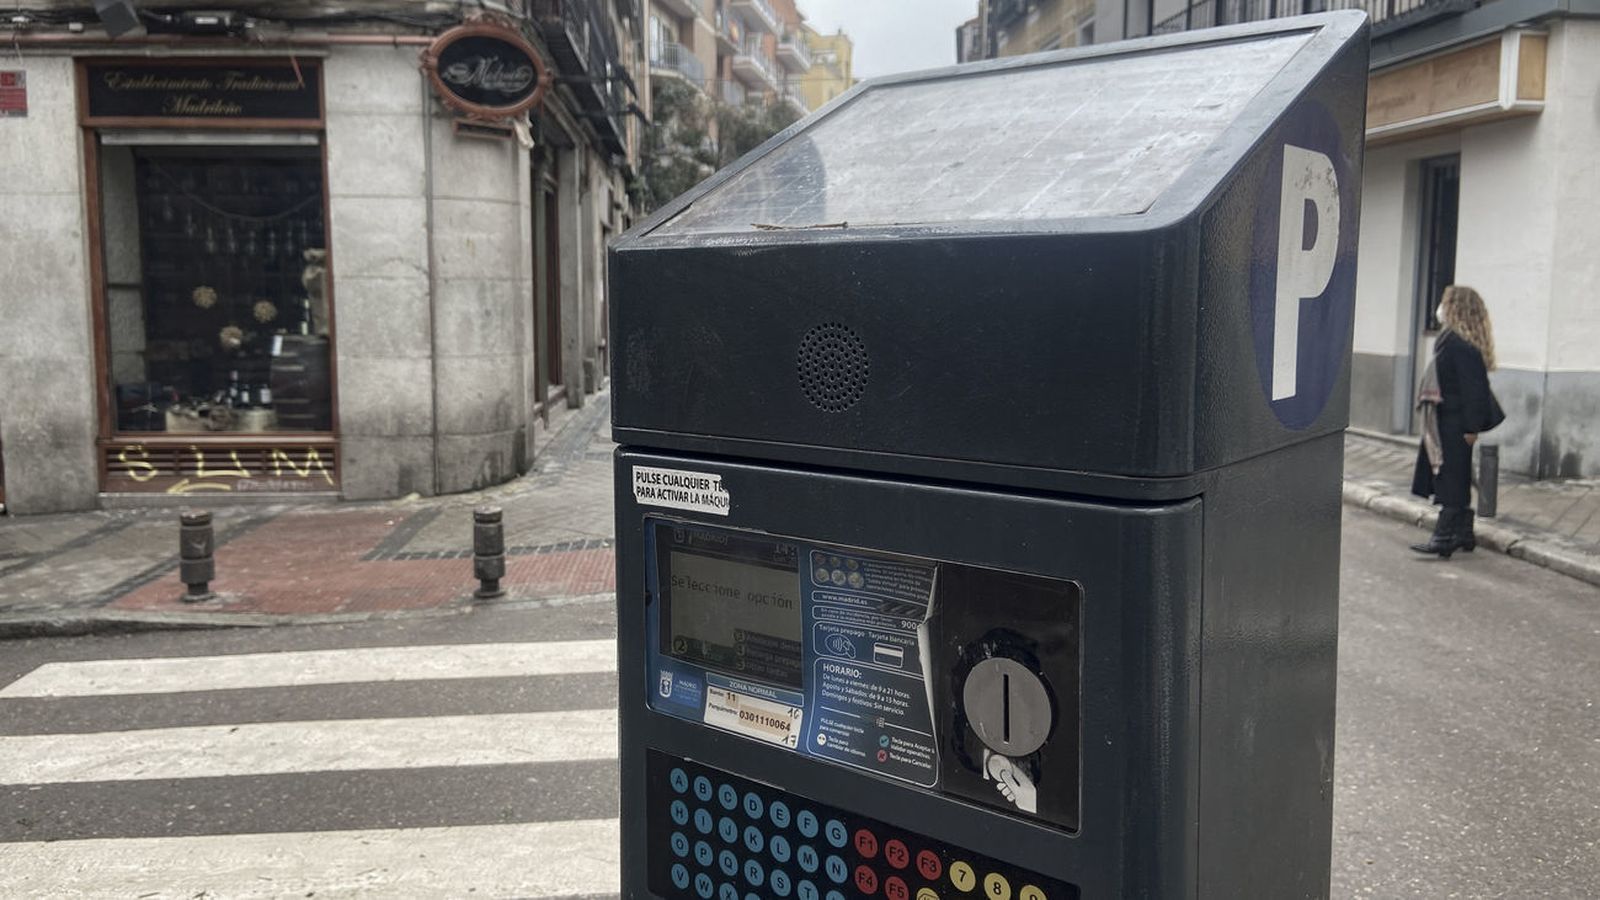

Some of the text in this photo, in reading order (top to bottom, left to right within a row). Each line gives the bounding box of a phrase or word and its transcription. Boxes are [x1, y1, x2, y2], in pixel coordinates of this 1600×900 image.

[1272, 144, 1340, 401] P
[636, 472, 661, 484] PULSE
[663, 475, 710, 490] CUALQUIER
[637, 486, 656, 498] PARA
[657, 489, 689, 503] ACTIVAR
[690, 493, 700, 504] LA
[672, 575, 793, 610] Seleccione opción
[822, 595, 868, 605] www.madrid.es
[819, 624, 840, 633] Tarjeta
[841, 628, 865, 638] prepago
[869, 632, 889, 641] Tarjeta
[676, 638, 685, 653] 2
[823, 664, 862, 679] HORARIO:
[727, 692, 736, 702] 11
[729, 680, 778, 699] ZONA NORMAL
[739, 709, 791, 732] 0301110064
[859, 835, 873, 850] F1
[889, 846, 904, 862] F2
[921, 857, 936, 873] F3
[859, 872, 873, 886] F4
[889, 883, 903, 897] F5
